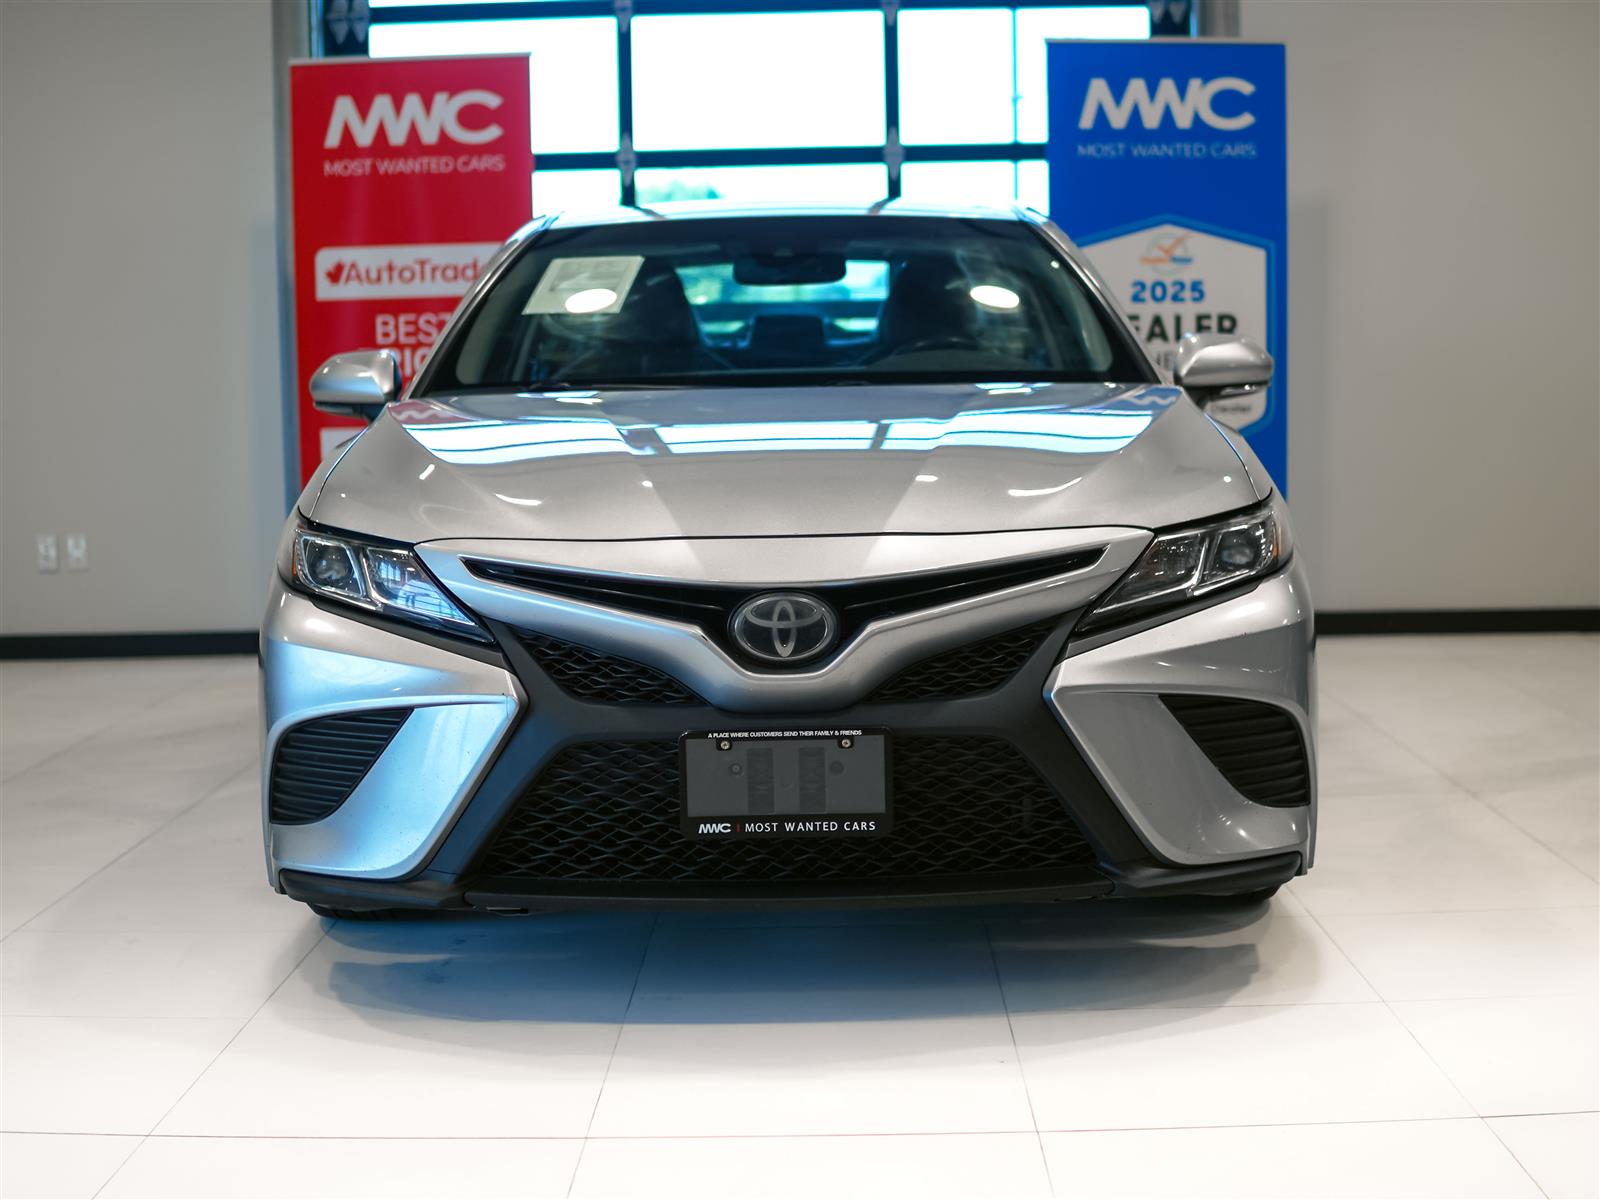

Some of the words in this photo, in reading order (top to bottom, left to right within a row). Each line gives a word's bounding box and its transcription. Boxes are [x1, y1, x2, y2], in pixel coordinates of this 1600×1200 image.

[1078, 77, 1256, 131] MWC
[323, 89, 504, 149] MWC
[1077, 143, 1126, 157] MOST
[1131, 142, 1207, 158] WANTED
[1210, 143, 1257, 158] CARS
[323, 158, 373, 177] MOST
[375, 156, 455, 175] WANTED
[456, 153, 506, 172] CARS
[344, 257, 483, 286] AutoTrad
[1130, 280, 1206, 303] 2025
[698, 823, 731, 834] MWC
[745, 823, 778, 832] MOST
[785, 822, 838, 832] WANTED
[844, 821, 876, 831] CARS
